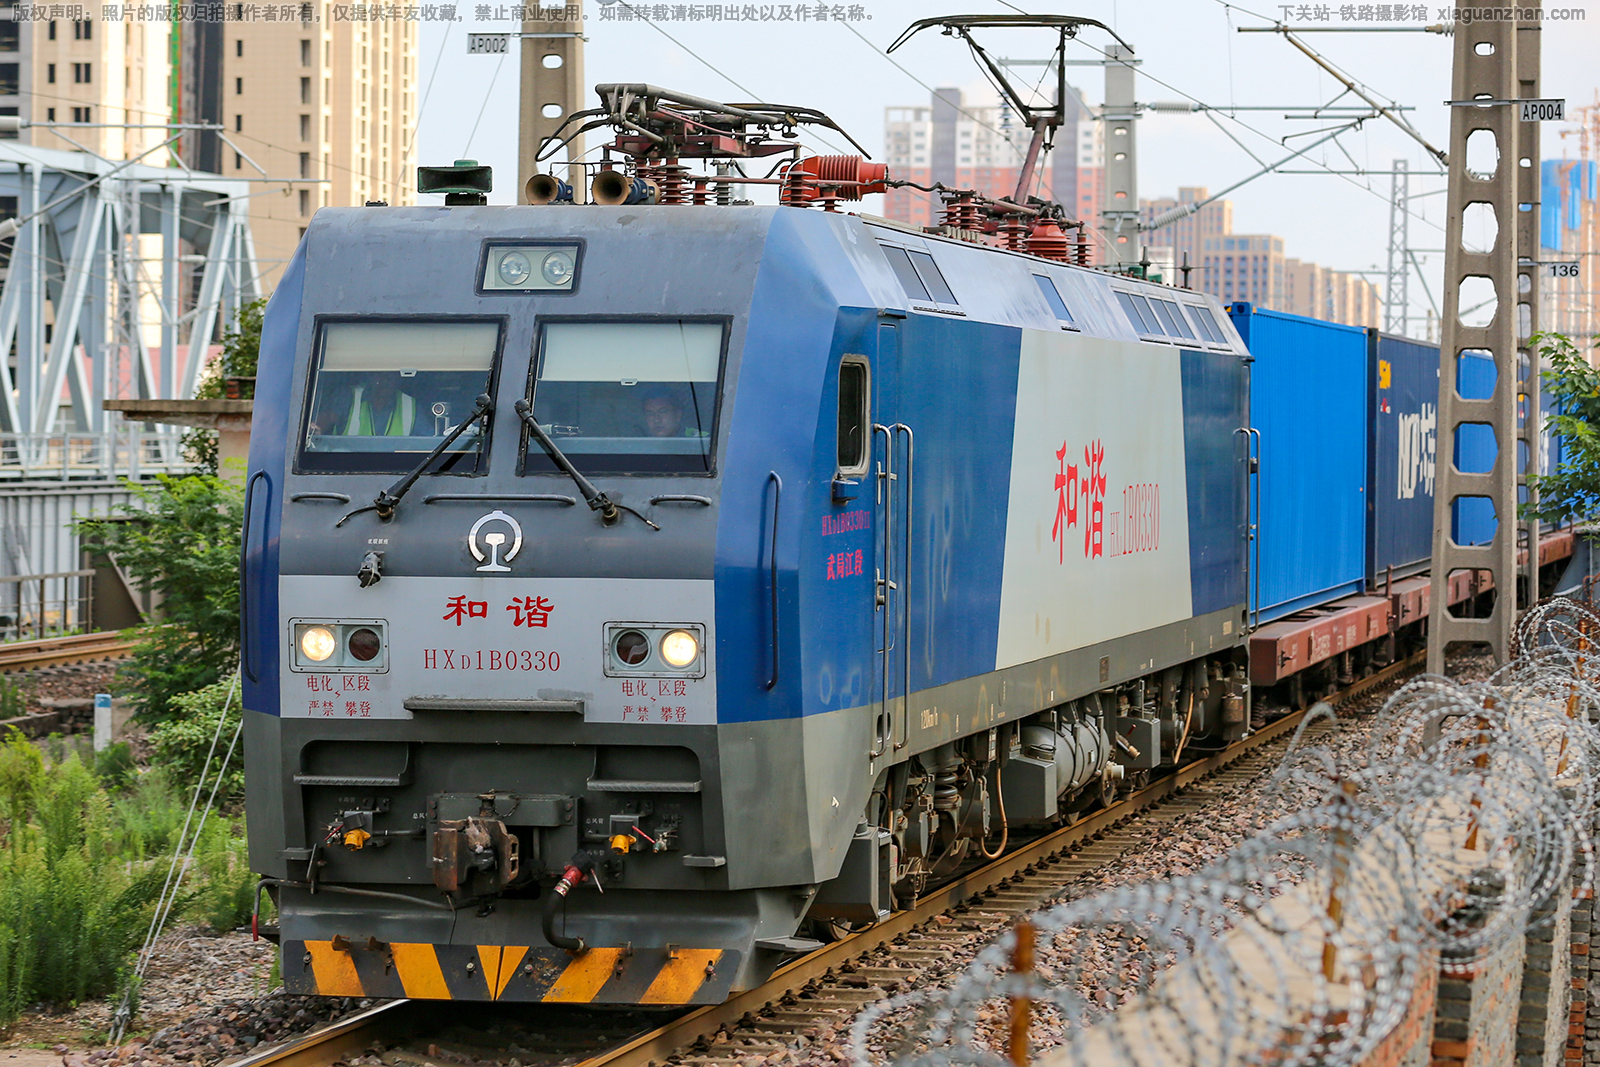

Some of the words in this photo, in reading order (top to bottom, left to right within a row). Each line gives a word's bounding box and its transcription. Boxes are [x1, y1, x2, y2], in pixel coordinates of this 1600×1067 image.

[469, 37, 507, 53] AP002
[1522, 103, 1562, 121] AP004
[1550, 265, 1579, 277] 136
[1051, 438, 1108, 566] 和谐
[442, 594, 555, 628] 和谐
[423, 648, 561, 672] HXD1B0330
